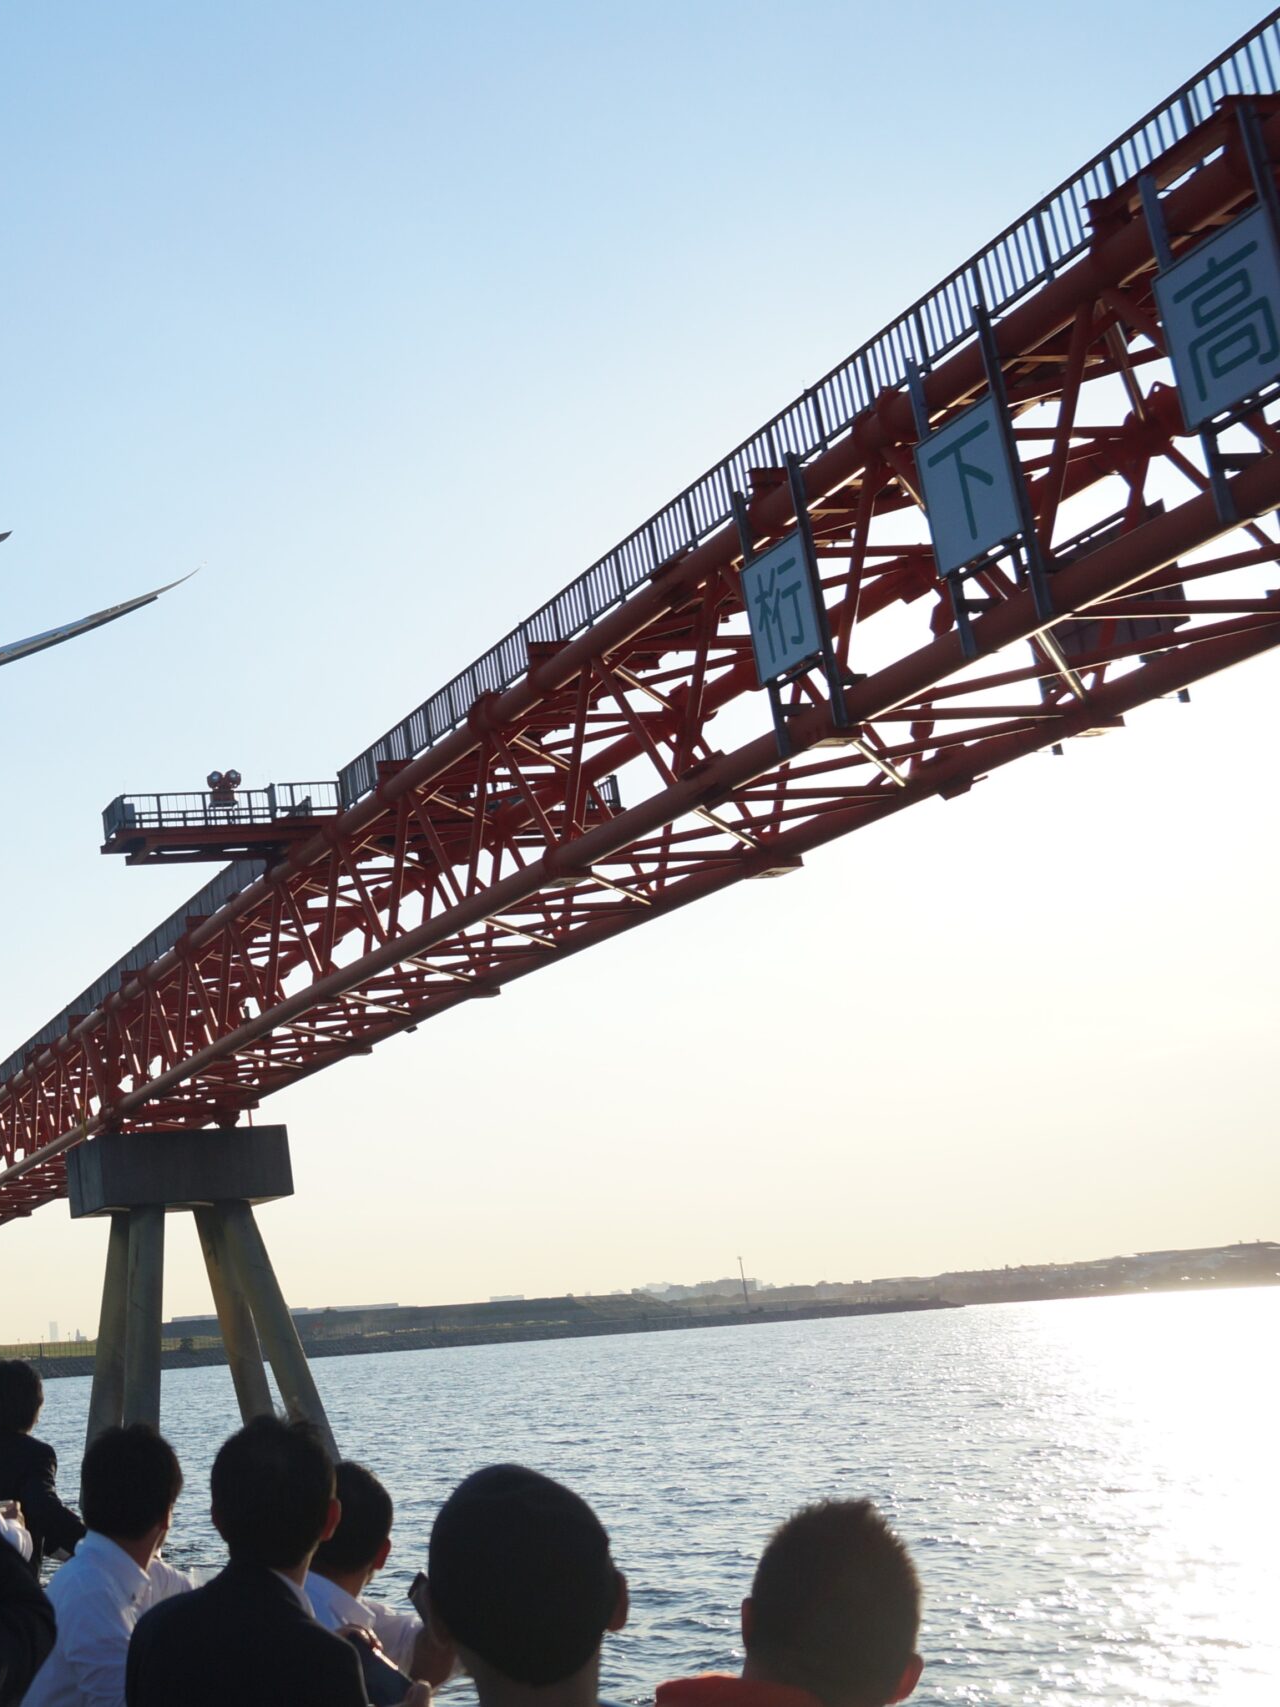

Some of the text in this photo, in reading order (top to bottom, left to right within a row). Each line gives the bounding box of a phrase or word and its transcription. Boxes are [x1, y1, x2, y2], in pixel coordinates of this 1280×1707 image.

[754, 240, 1280, 664] 桁 下 高
